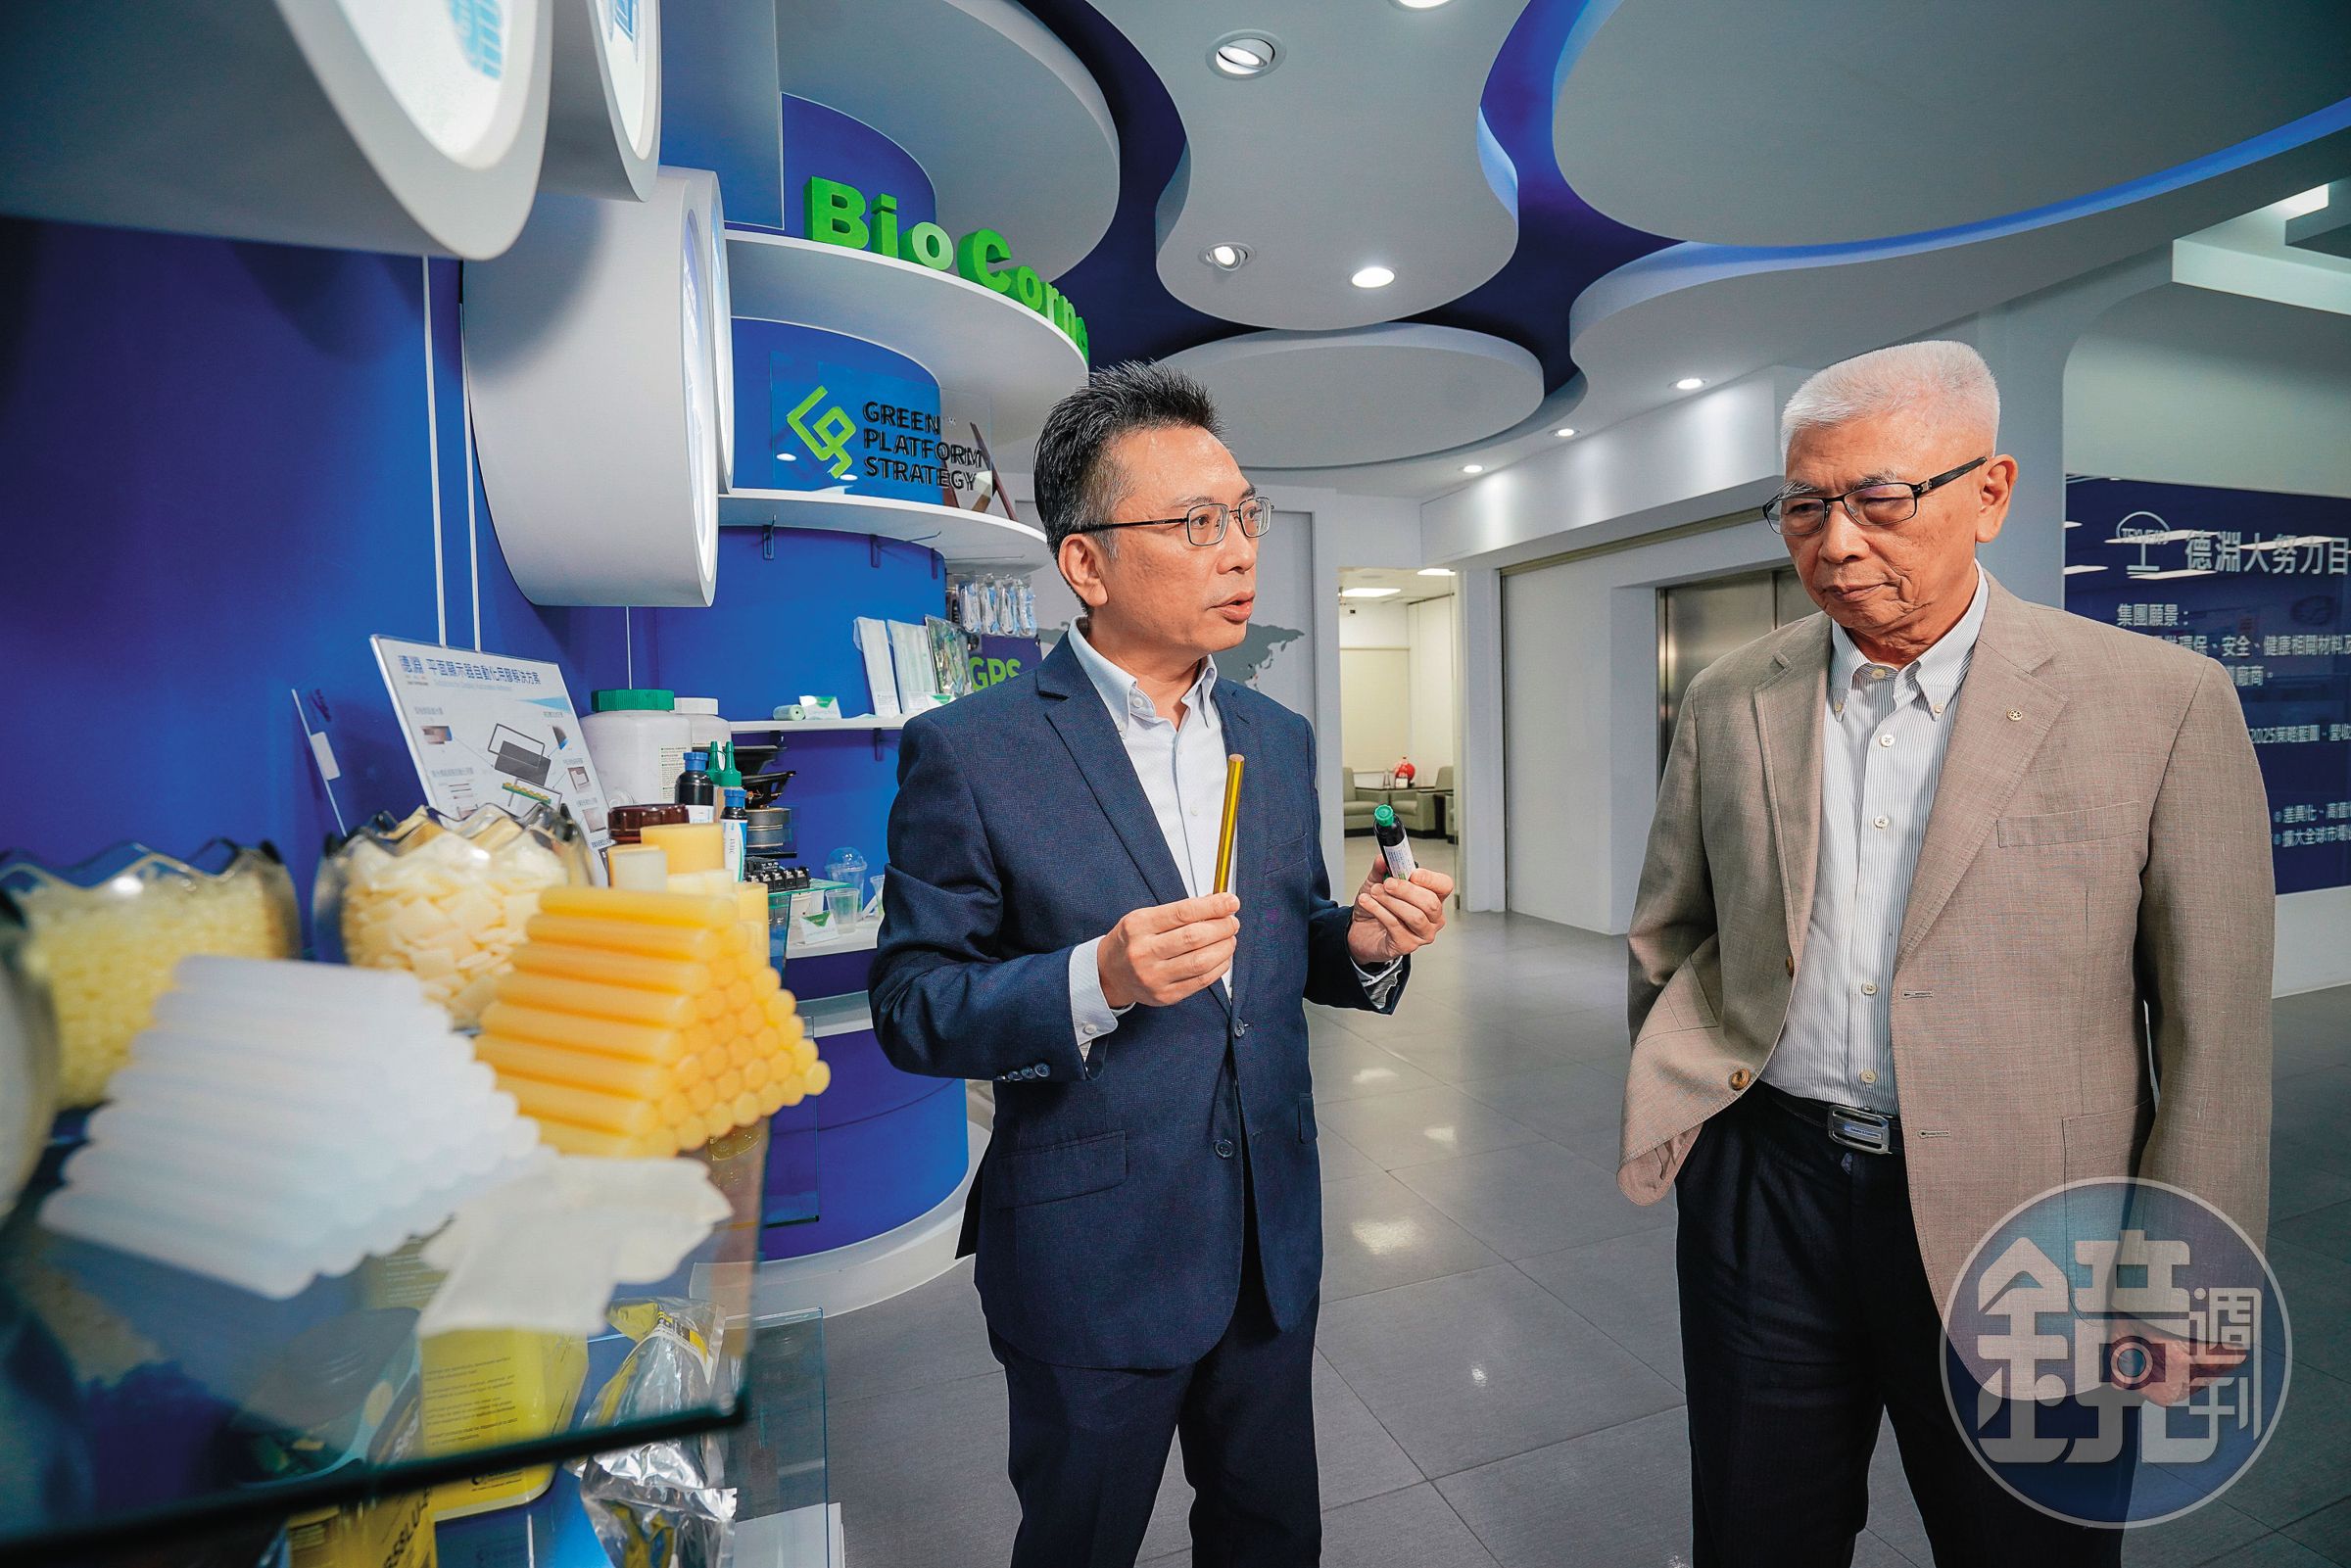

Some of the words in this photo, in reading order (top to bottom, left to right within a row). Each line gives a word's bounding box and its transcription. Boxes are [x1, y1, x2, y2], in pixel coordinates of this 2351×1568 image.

[803, 176, 954, 270] Bio
[862, 401, 940, 435] GREEN
[863, 428, 983, 468] PLATFORM
[863, 455, 978, 491] STRATEGY
